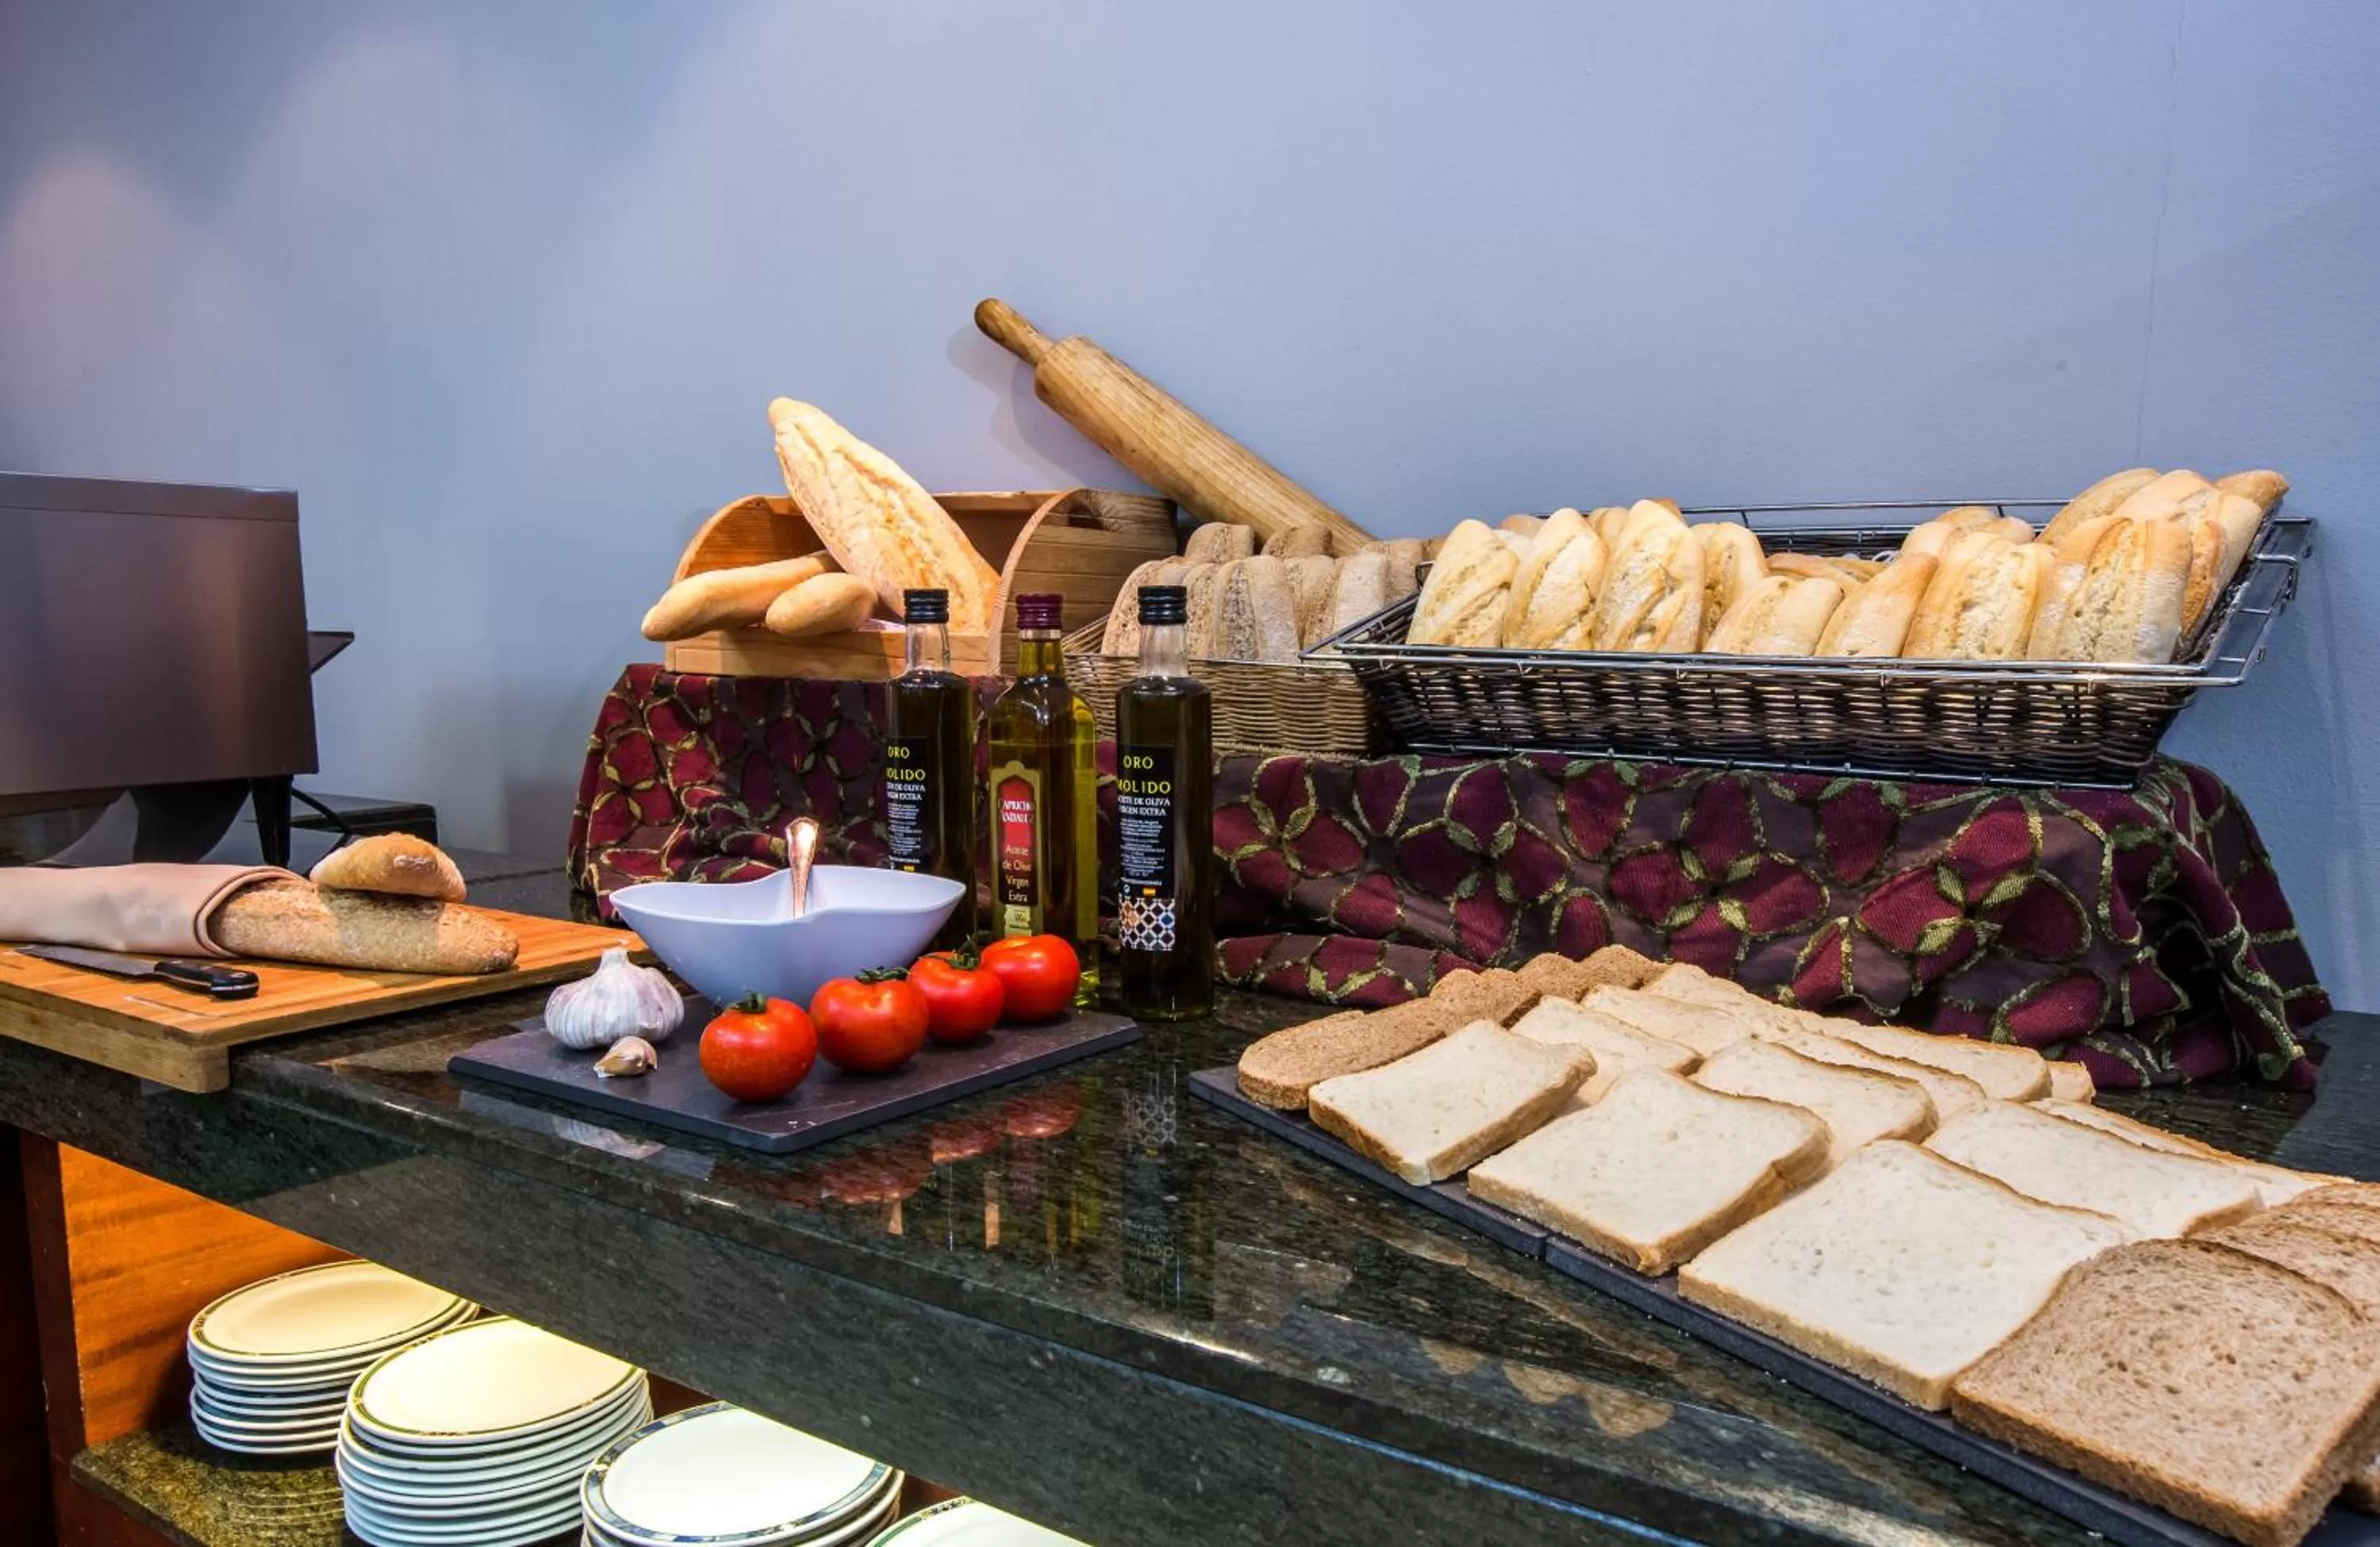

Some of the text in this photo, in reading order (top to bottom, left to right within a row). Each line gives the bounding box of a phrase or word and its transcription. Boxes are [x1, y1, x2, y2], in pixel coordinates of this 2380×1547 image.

[888, 746, 910, 758] ORO
[1123, 755, 1154, 770] ORO
[1134, 797, 1144, 805] DE
[1145, 797, 1170, 807] OLIVA
[1139, 806, 1167, 816] EXTRA
[1004, 843, 1030, 857] Aceite
[1002, 859, 1032, 872] de Oliva
[1005, 874, 1030, 889] Virgen
[1008, 889, 1028, 902] Extra
